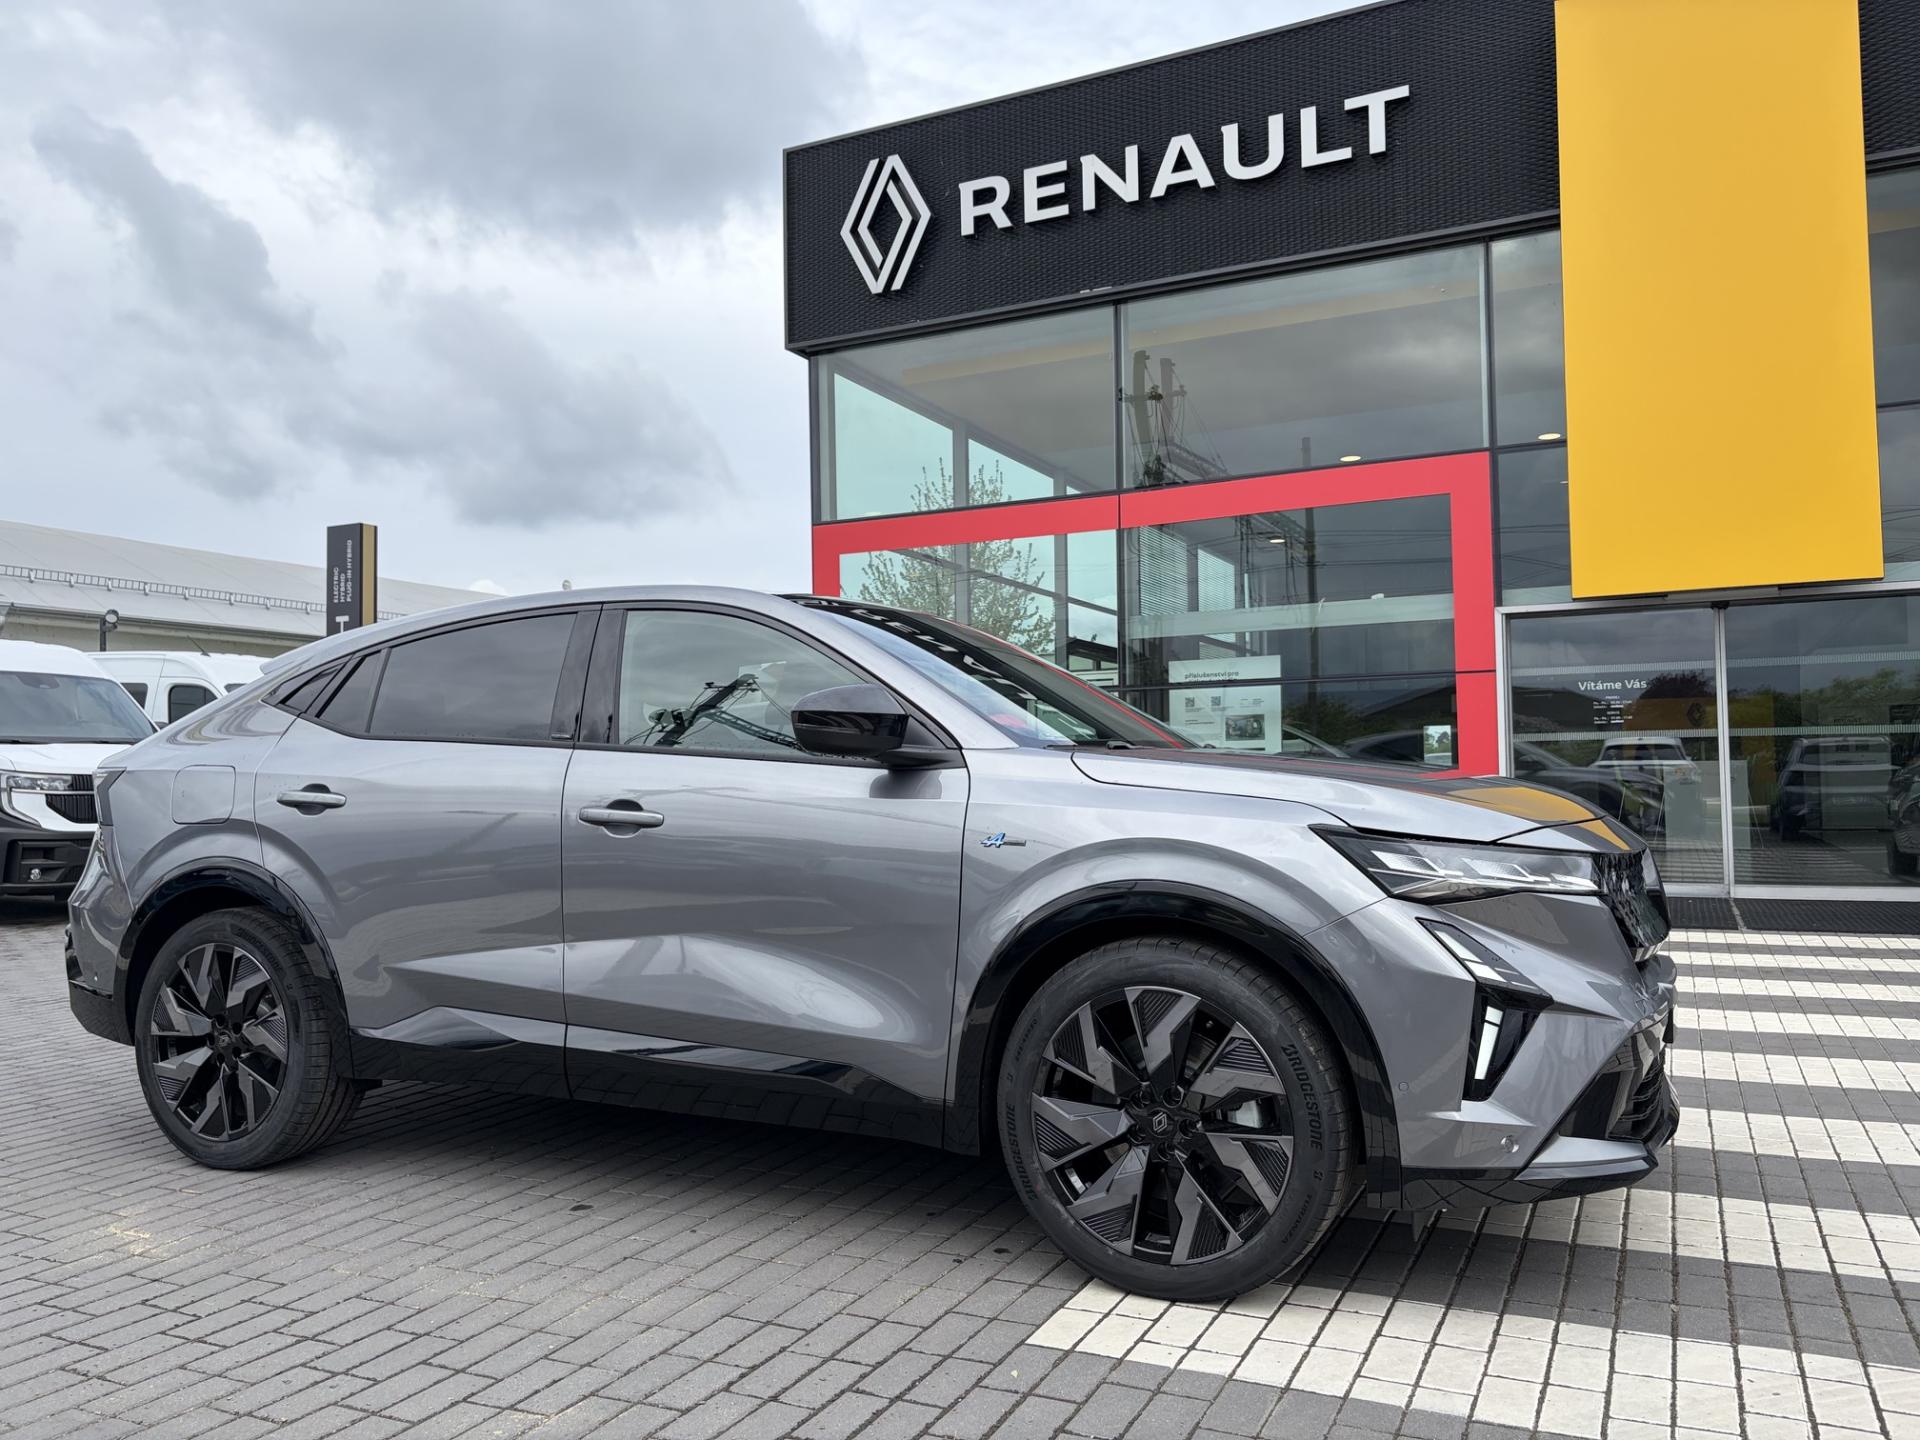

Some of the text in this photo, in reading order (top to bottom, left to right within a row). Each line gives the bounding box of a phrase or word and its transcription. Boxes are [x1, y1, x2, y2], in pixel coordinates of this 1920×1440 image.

[959, 85, 1410, 236] RENAULT
[1227, 671, 1240, 679] pro
[1578, 678, 1647, 691] Vítáme Vás
[1281, 1043, 1323, 1152] BRIDGESTONE
[1005, 1102, 1039, 1202] BRIDGESTONE
